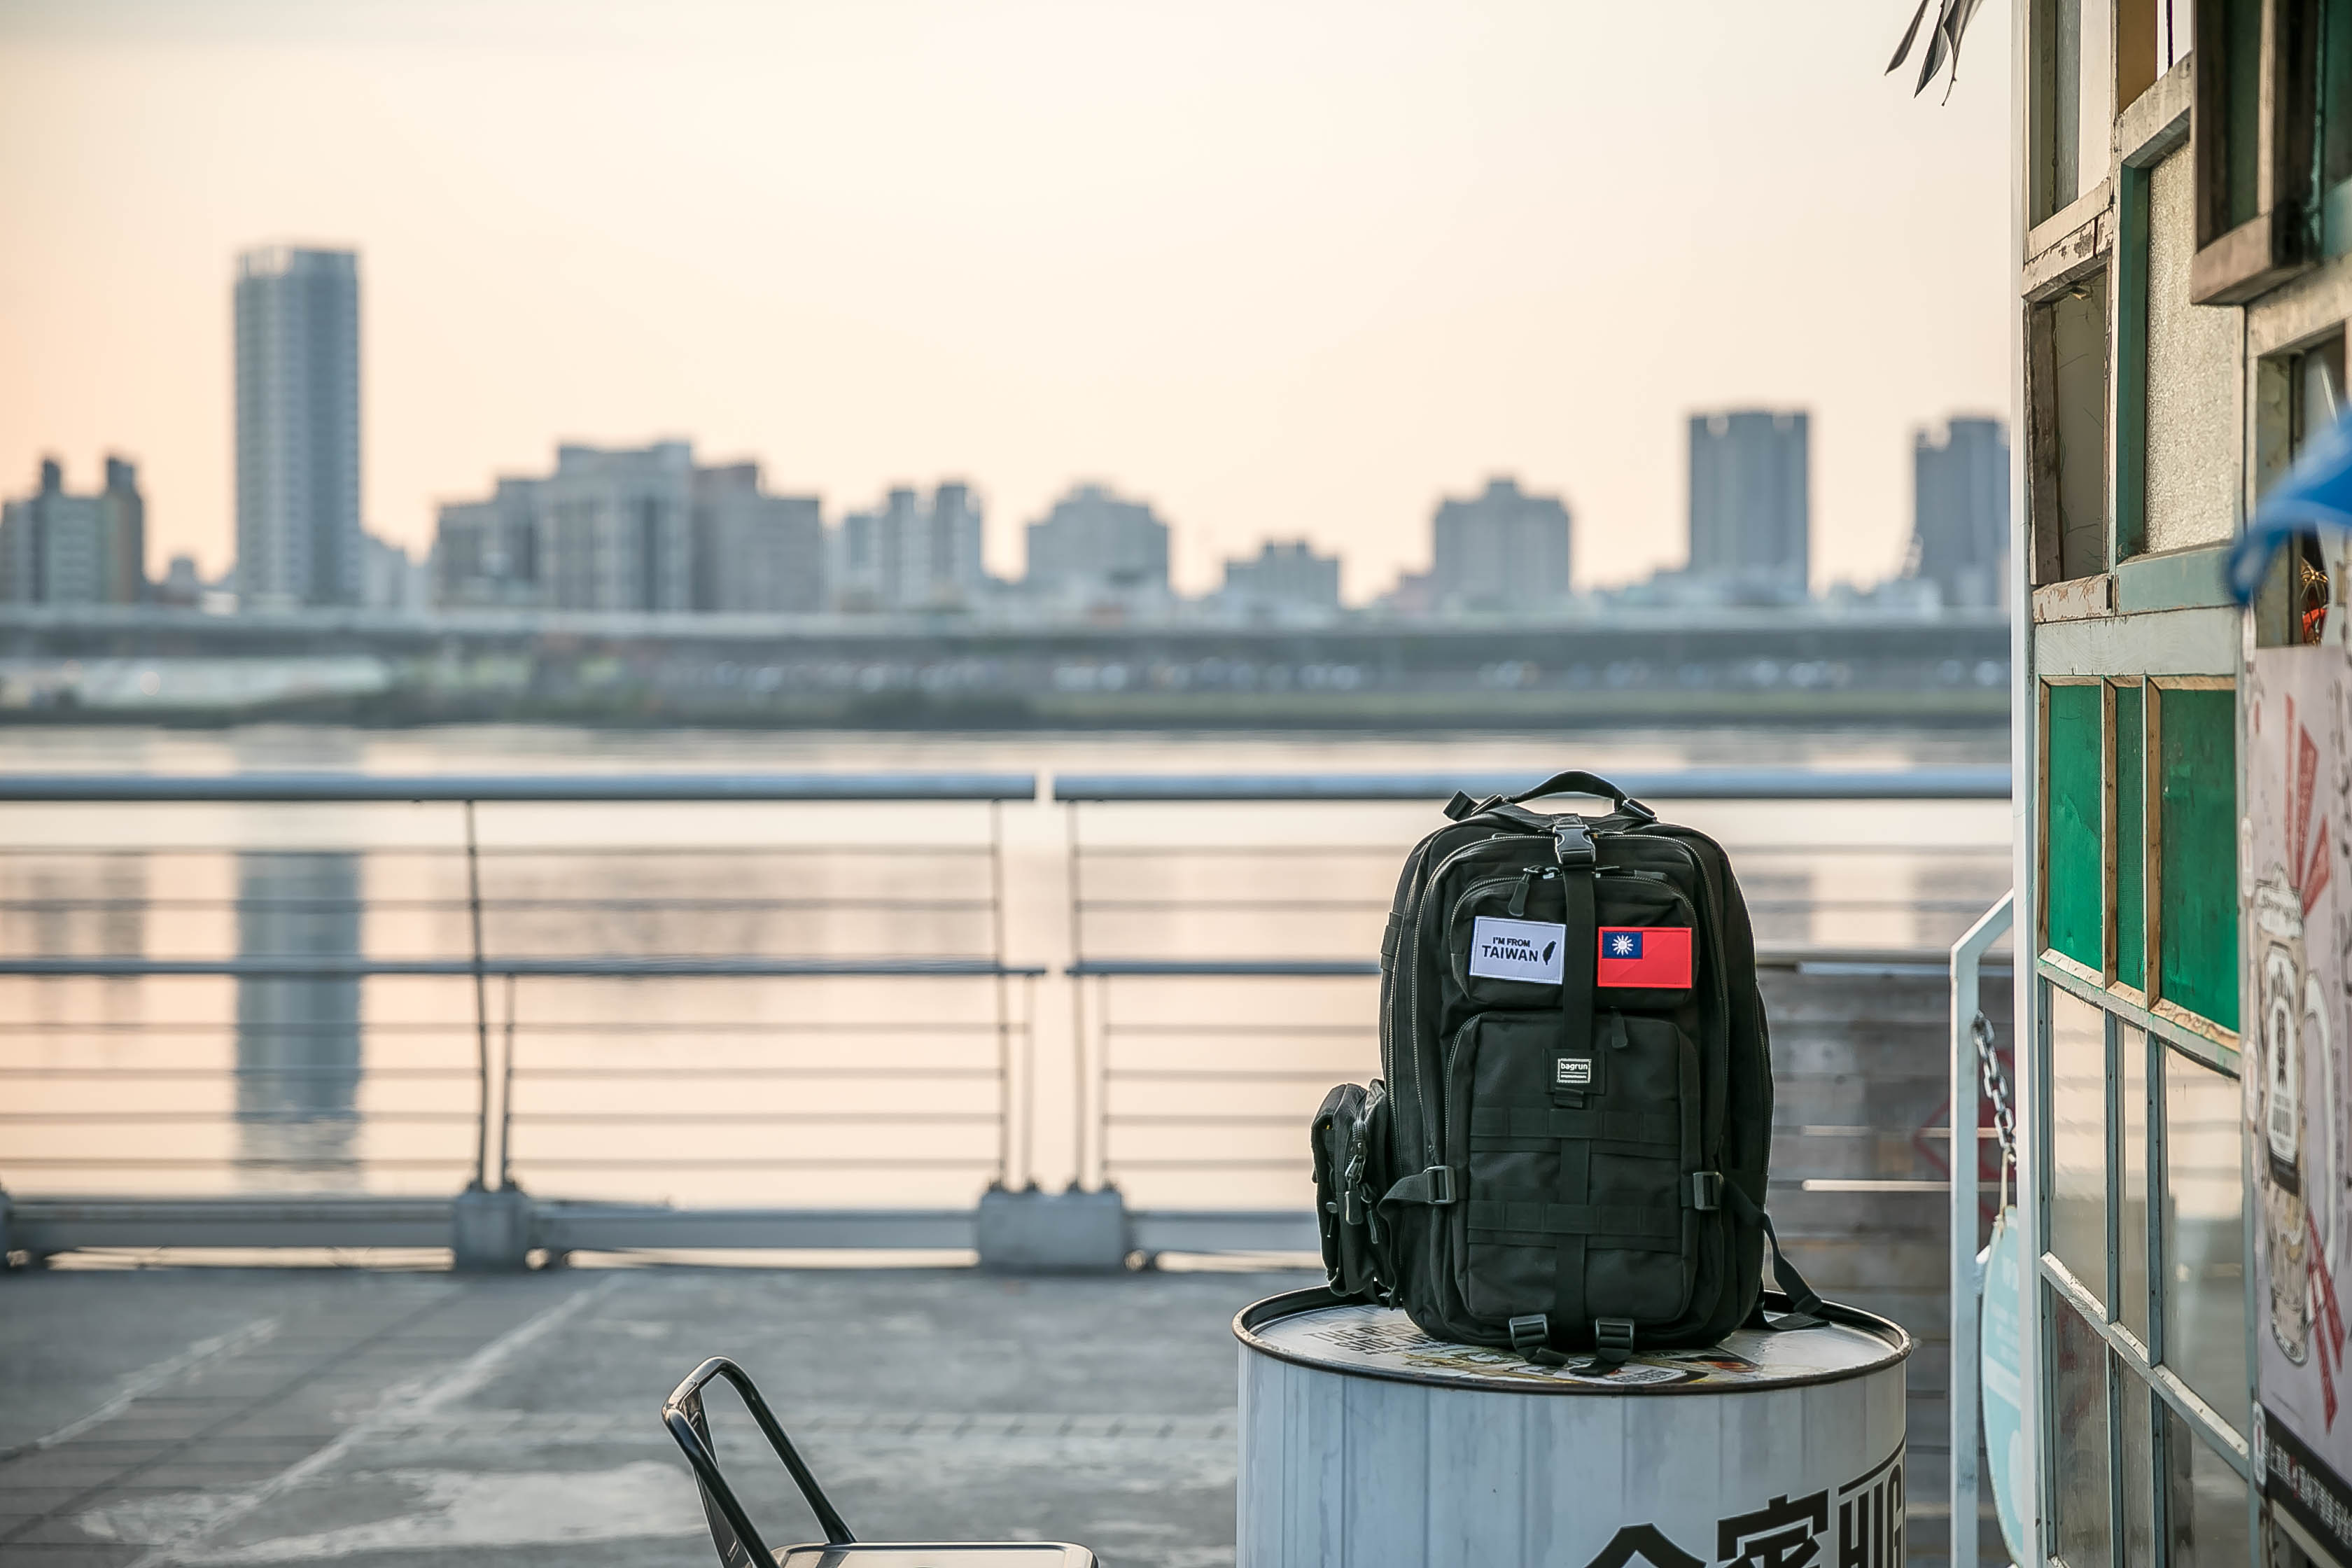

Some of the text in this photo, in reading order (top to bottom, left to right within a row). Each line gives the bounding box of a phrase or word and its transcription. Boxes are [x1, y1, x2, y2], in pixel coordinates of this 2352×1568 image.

[1492, 937, 1531, 948] I'M FROM
[1482, 945, 1539, 962] TAIWAN
[1302, 1329, 1368, 1342] THE
[1334, 1338, 1408, 1352] SIDE
[1839, 1456, 1905, 1568] HIG
